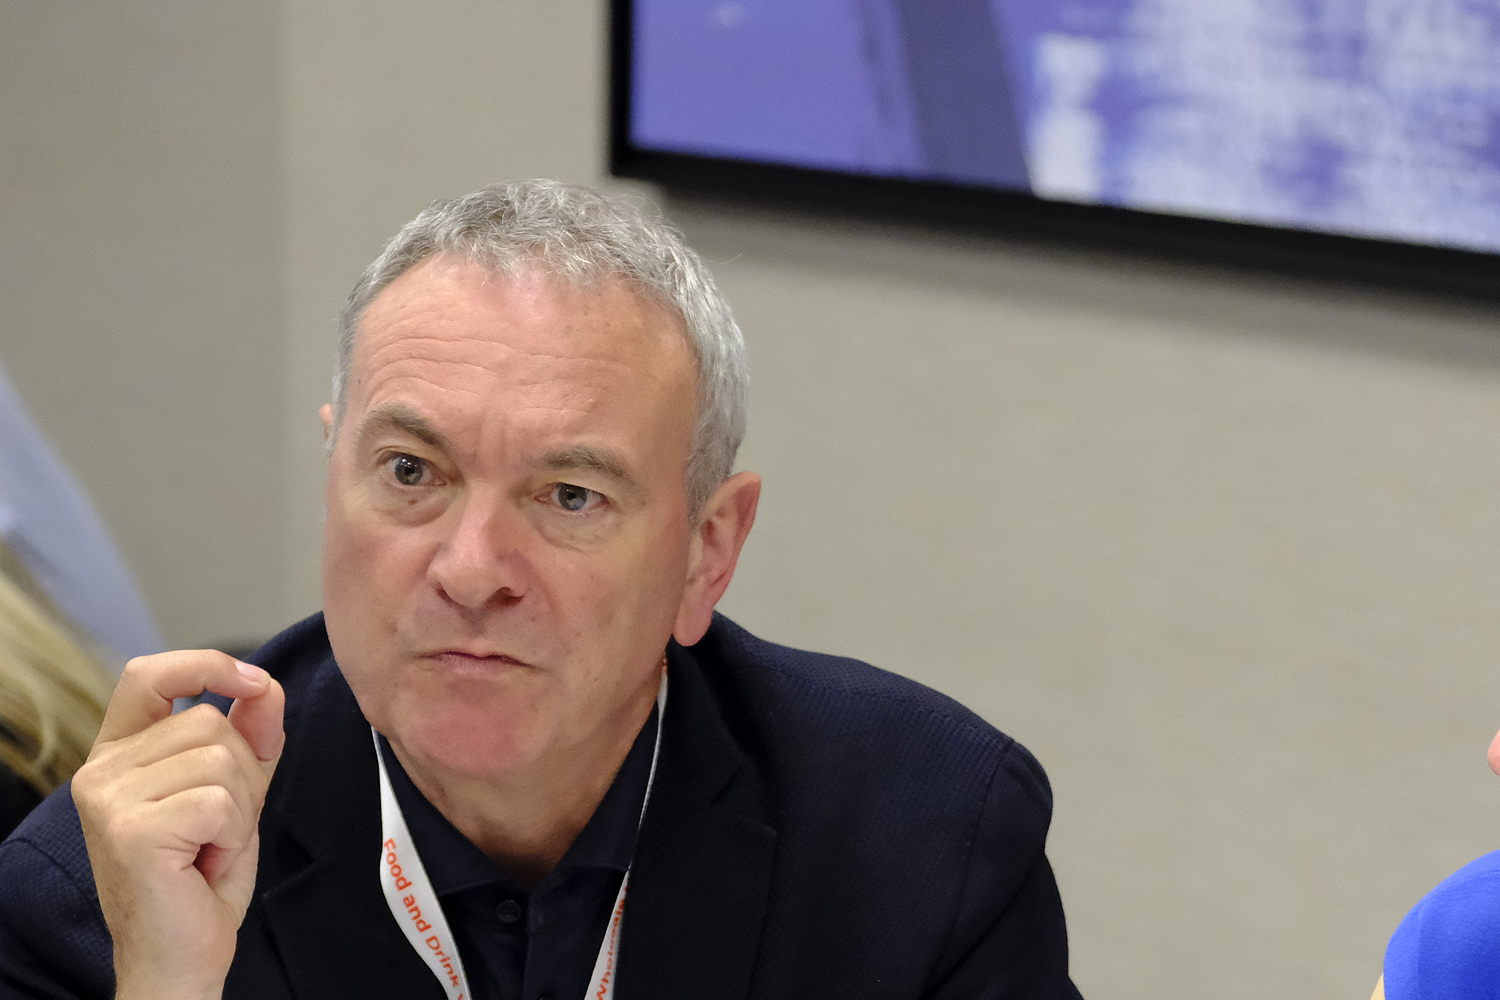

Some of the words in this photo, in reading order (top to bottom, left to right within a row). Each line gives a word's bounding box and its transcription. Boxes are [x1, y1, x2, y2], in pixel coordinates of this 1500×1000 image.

[383, 837, 413, 892] Food
[402, 893, 432, 934] and
[424, 934, 459, 988] Drink
